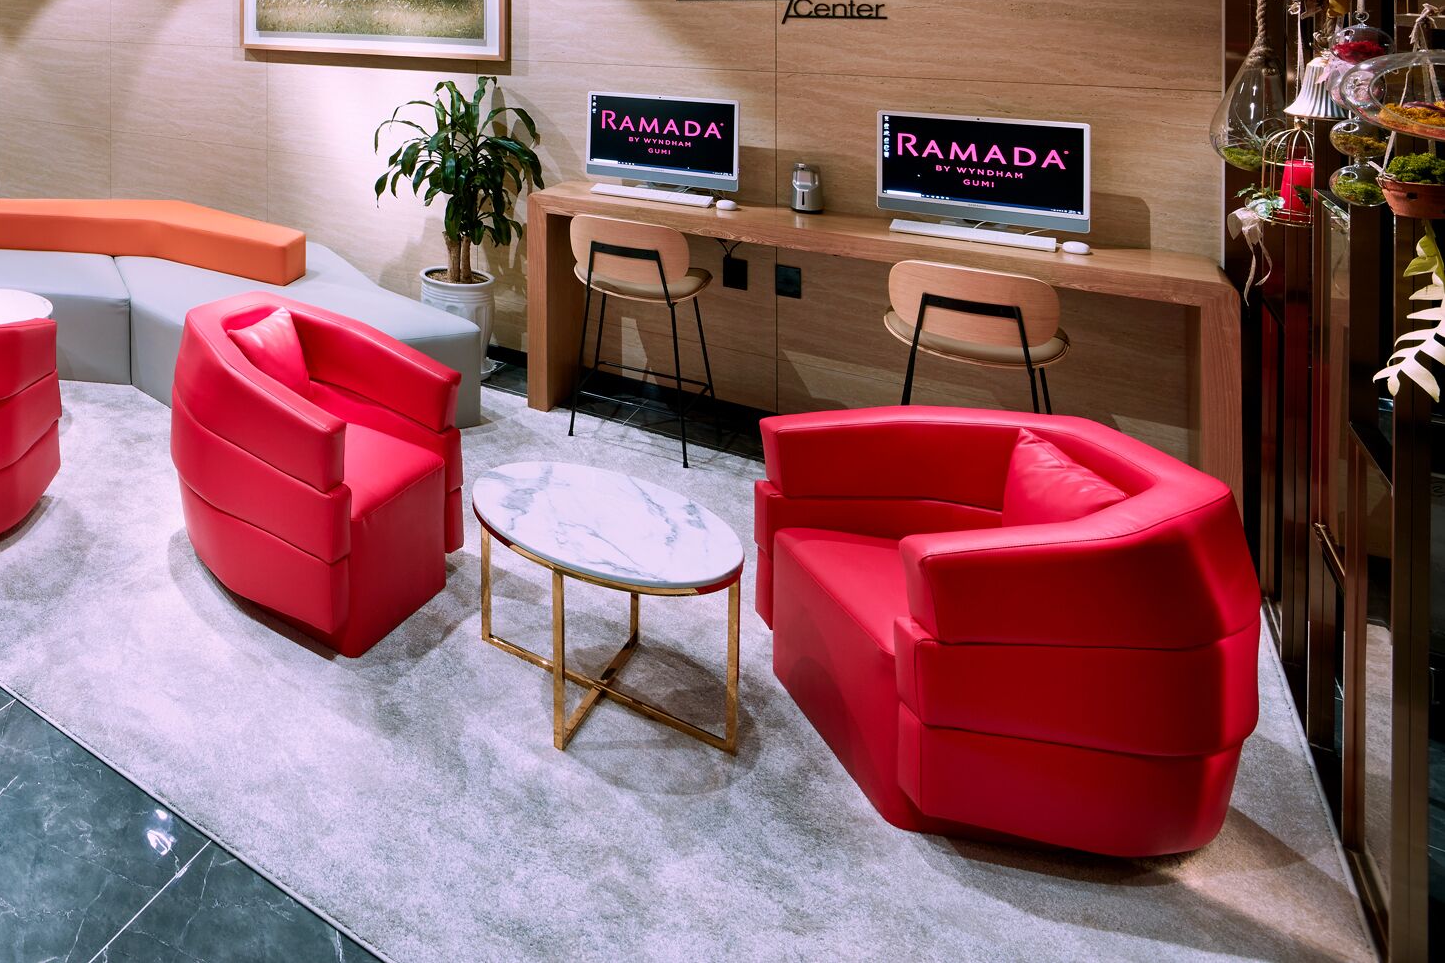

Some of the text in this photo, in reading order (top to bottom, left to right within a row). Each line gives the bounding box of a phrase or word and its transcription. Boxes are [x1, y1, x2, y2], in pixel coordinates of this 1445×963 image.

[601, 109, 722, 139] RAMADA
[643, 137, 692, 148] WYNDHAM
[647, 147, 671, 155] GUMI
[897, 132, 1067, 170] RAMADA
[935, 164, 1024, 179] BY WYNDHAM
[963, 178, 995, 188] GUMI
